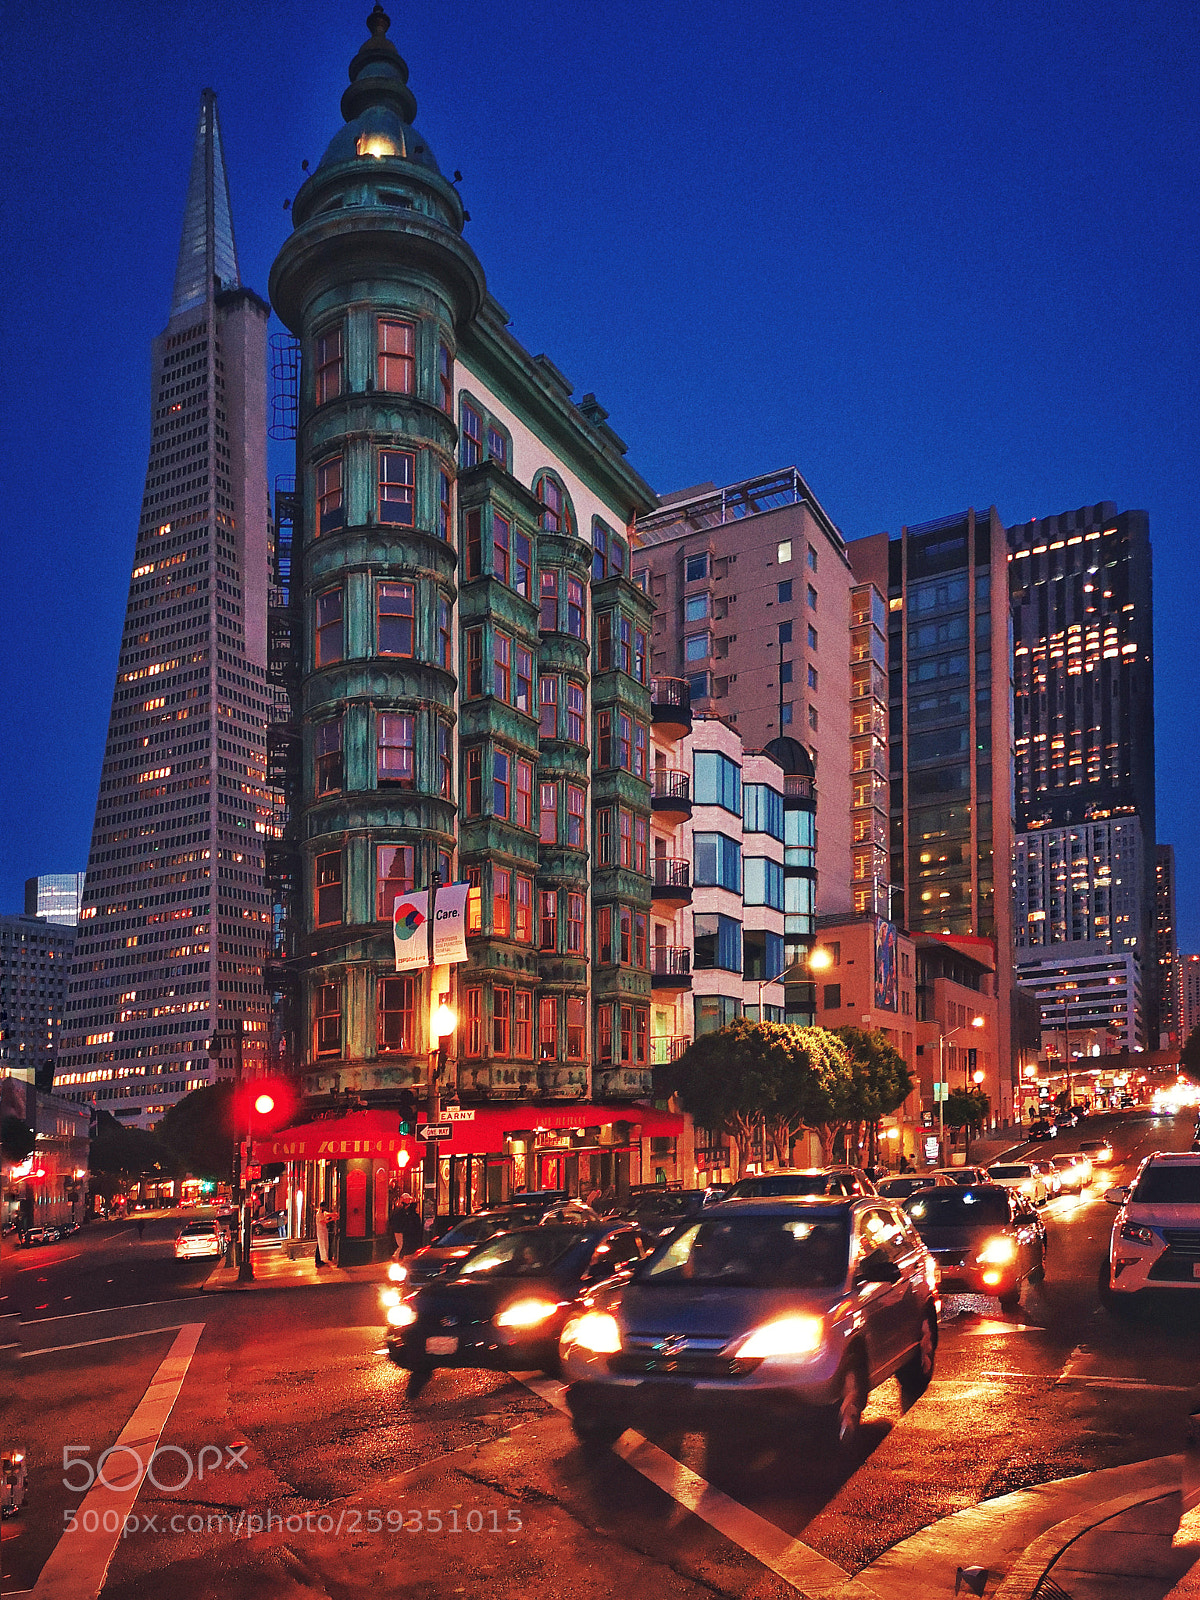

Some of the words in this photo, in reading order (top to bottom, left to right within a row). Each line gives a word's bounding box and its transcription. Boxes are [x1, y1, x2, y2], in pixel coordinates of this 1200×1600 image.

[436, 909, 460, 920] Care.
[440, 1112, 473, 1120] EARNY
[427, 1128, 436, 1136] ONE
[438, 1127, 449, 1135] WAY
